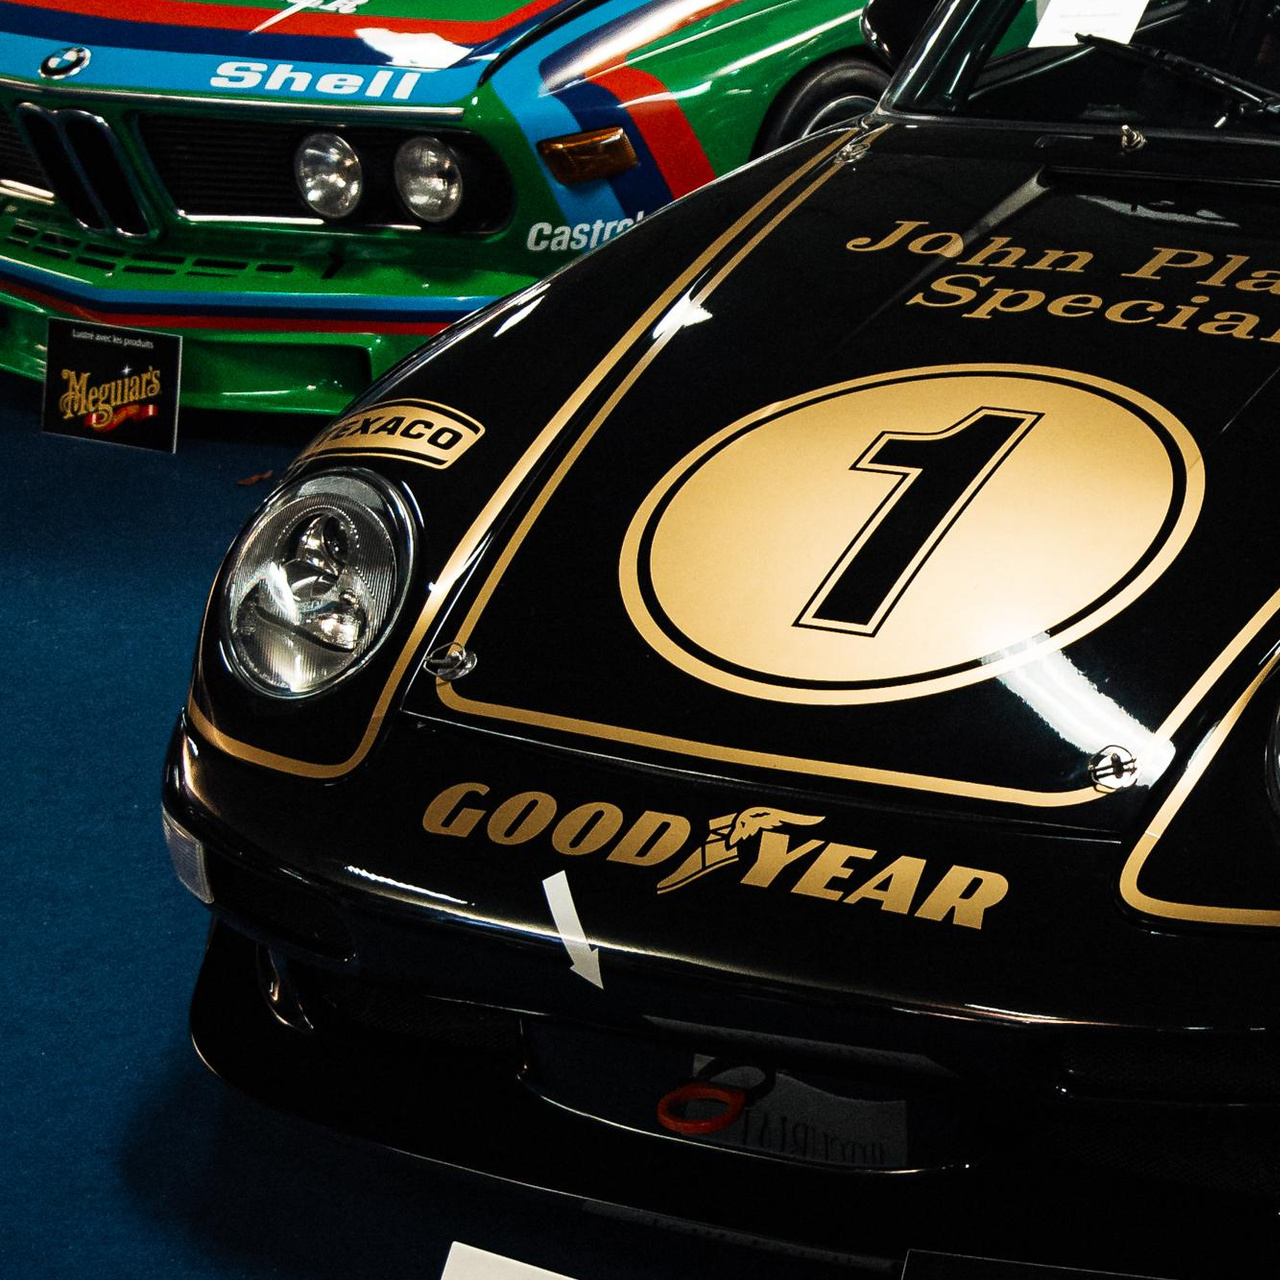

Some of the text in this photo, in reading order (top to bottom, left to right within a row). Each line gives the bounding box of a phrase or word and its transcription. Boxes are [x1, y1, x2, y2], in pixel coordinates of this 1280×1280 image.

[210, 61, 422, 100] Shell
[845, 220, 1094, 273] John
[791, 406, 1046, 638] 1
